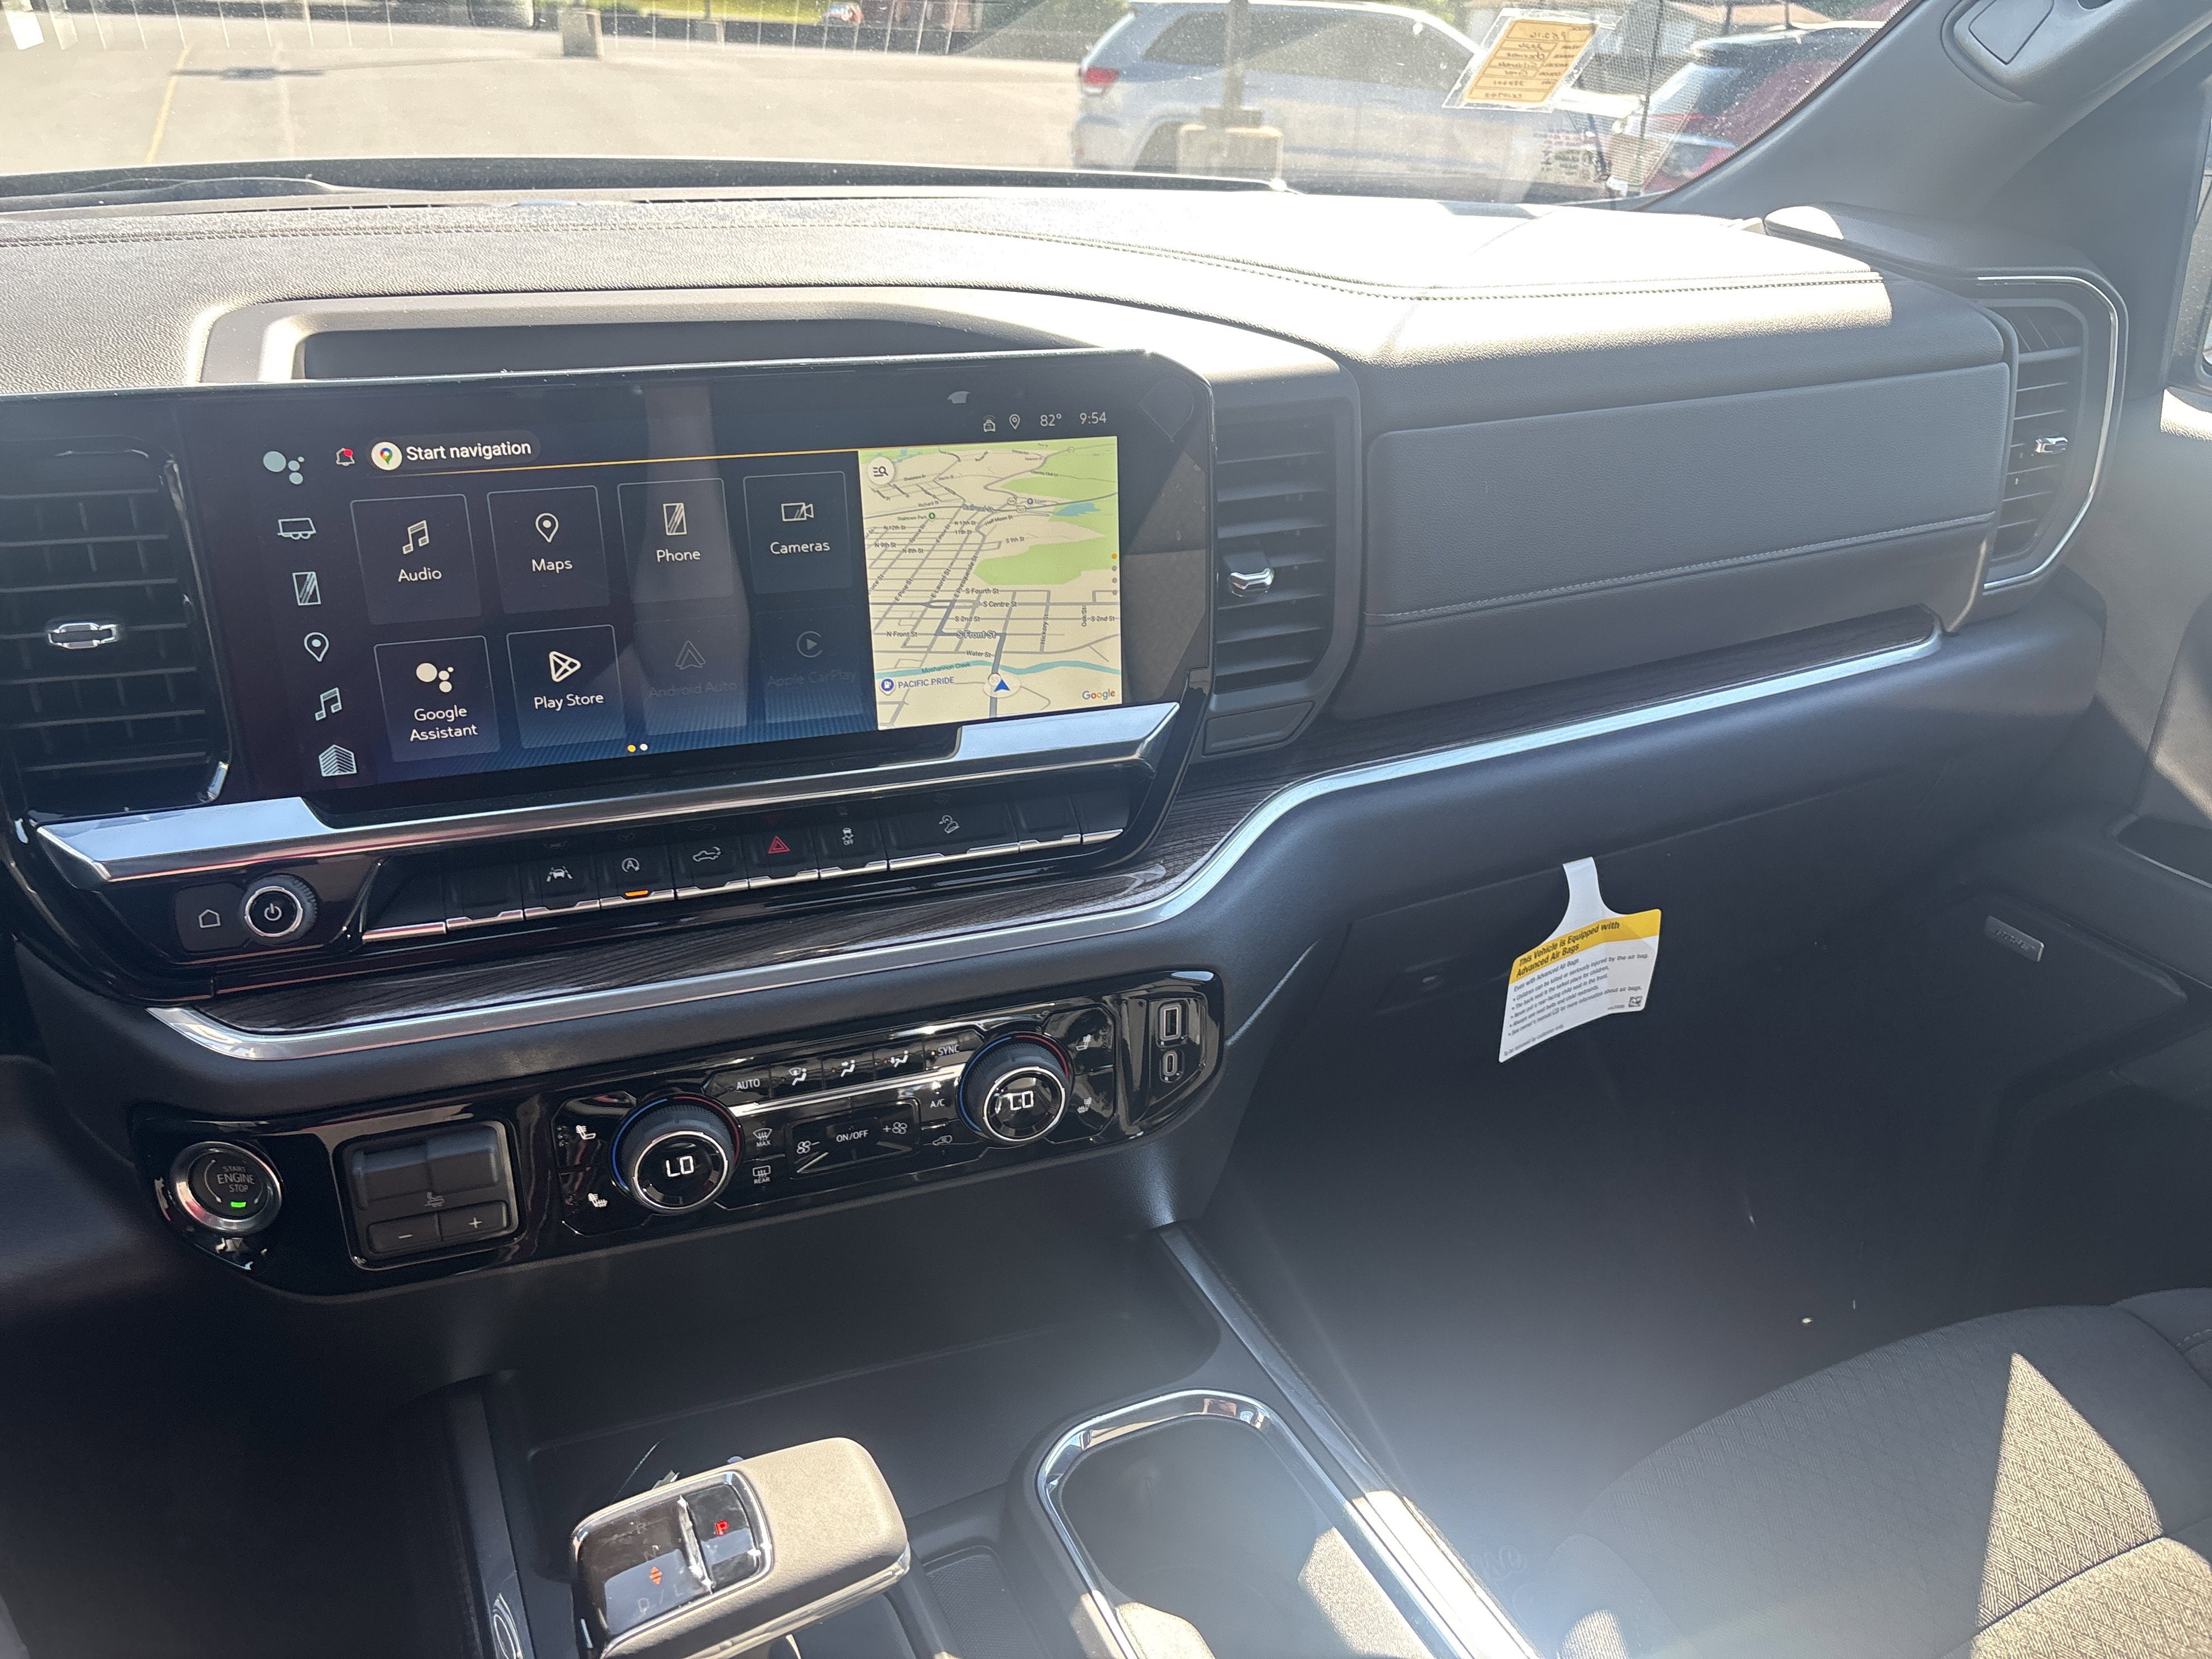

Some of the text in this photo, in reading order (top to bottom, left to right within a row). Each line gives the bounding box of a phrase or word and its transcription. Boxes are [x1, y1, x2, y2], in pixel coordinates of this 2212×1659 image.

[1079, 411, 1107, 425] 9:54
[407, 441, 532, 461] Start navigation
[656, 548, 701, 563] Phone
[770, 541, 831, 555] Cameras
[532, 558, 573, 574] Maps
[398, 566, 442, 582] Audio
[898, 583, 909, 598] Pine
[935, 574, 947, 593] Laurel
[1040, 621, 1049, 644] Hickory
[808, 669, 857, 684] CarPlay
[921, 664, 955, 674] Moshannon
[648, 680, 738, 698] Android Auto
[898, 676, 955, 689] PACIFIC PRIDE
[534, 693, 604, 712] Play Store
[1082, 689, 1116, 701] Google
[414, 705, 468, 723] Google
[410, 724, 478, 742] Assistant
[1519, 921, 1620, 967] This Vehicle is Equipped with
[1516, 943, 1580, 978] Advanced Air Bags
[1536, 966, 1559, 980] Advanced
[937, 1044, 960, 1056] SYNC
[736, 1078, 761, 1090] AUTO
[929, 1098, 945, 1109] A/C
[836, 1129, 870, 1143] ON/OFF
[665, 1155, 695, 1178] LO
[217, 1172, 256, 1185] ENGINE
[753, 1176, 771, 1184] REAR
[229, 1184, 249, 1193] STOP
[715, 1520, 729, 1536] P
